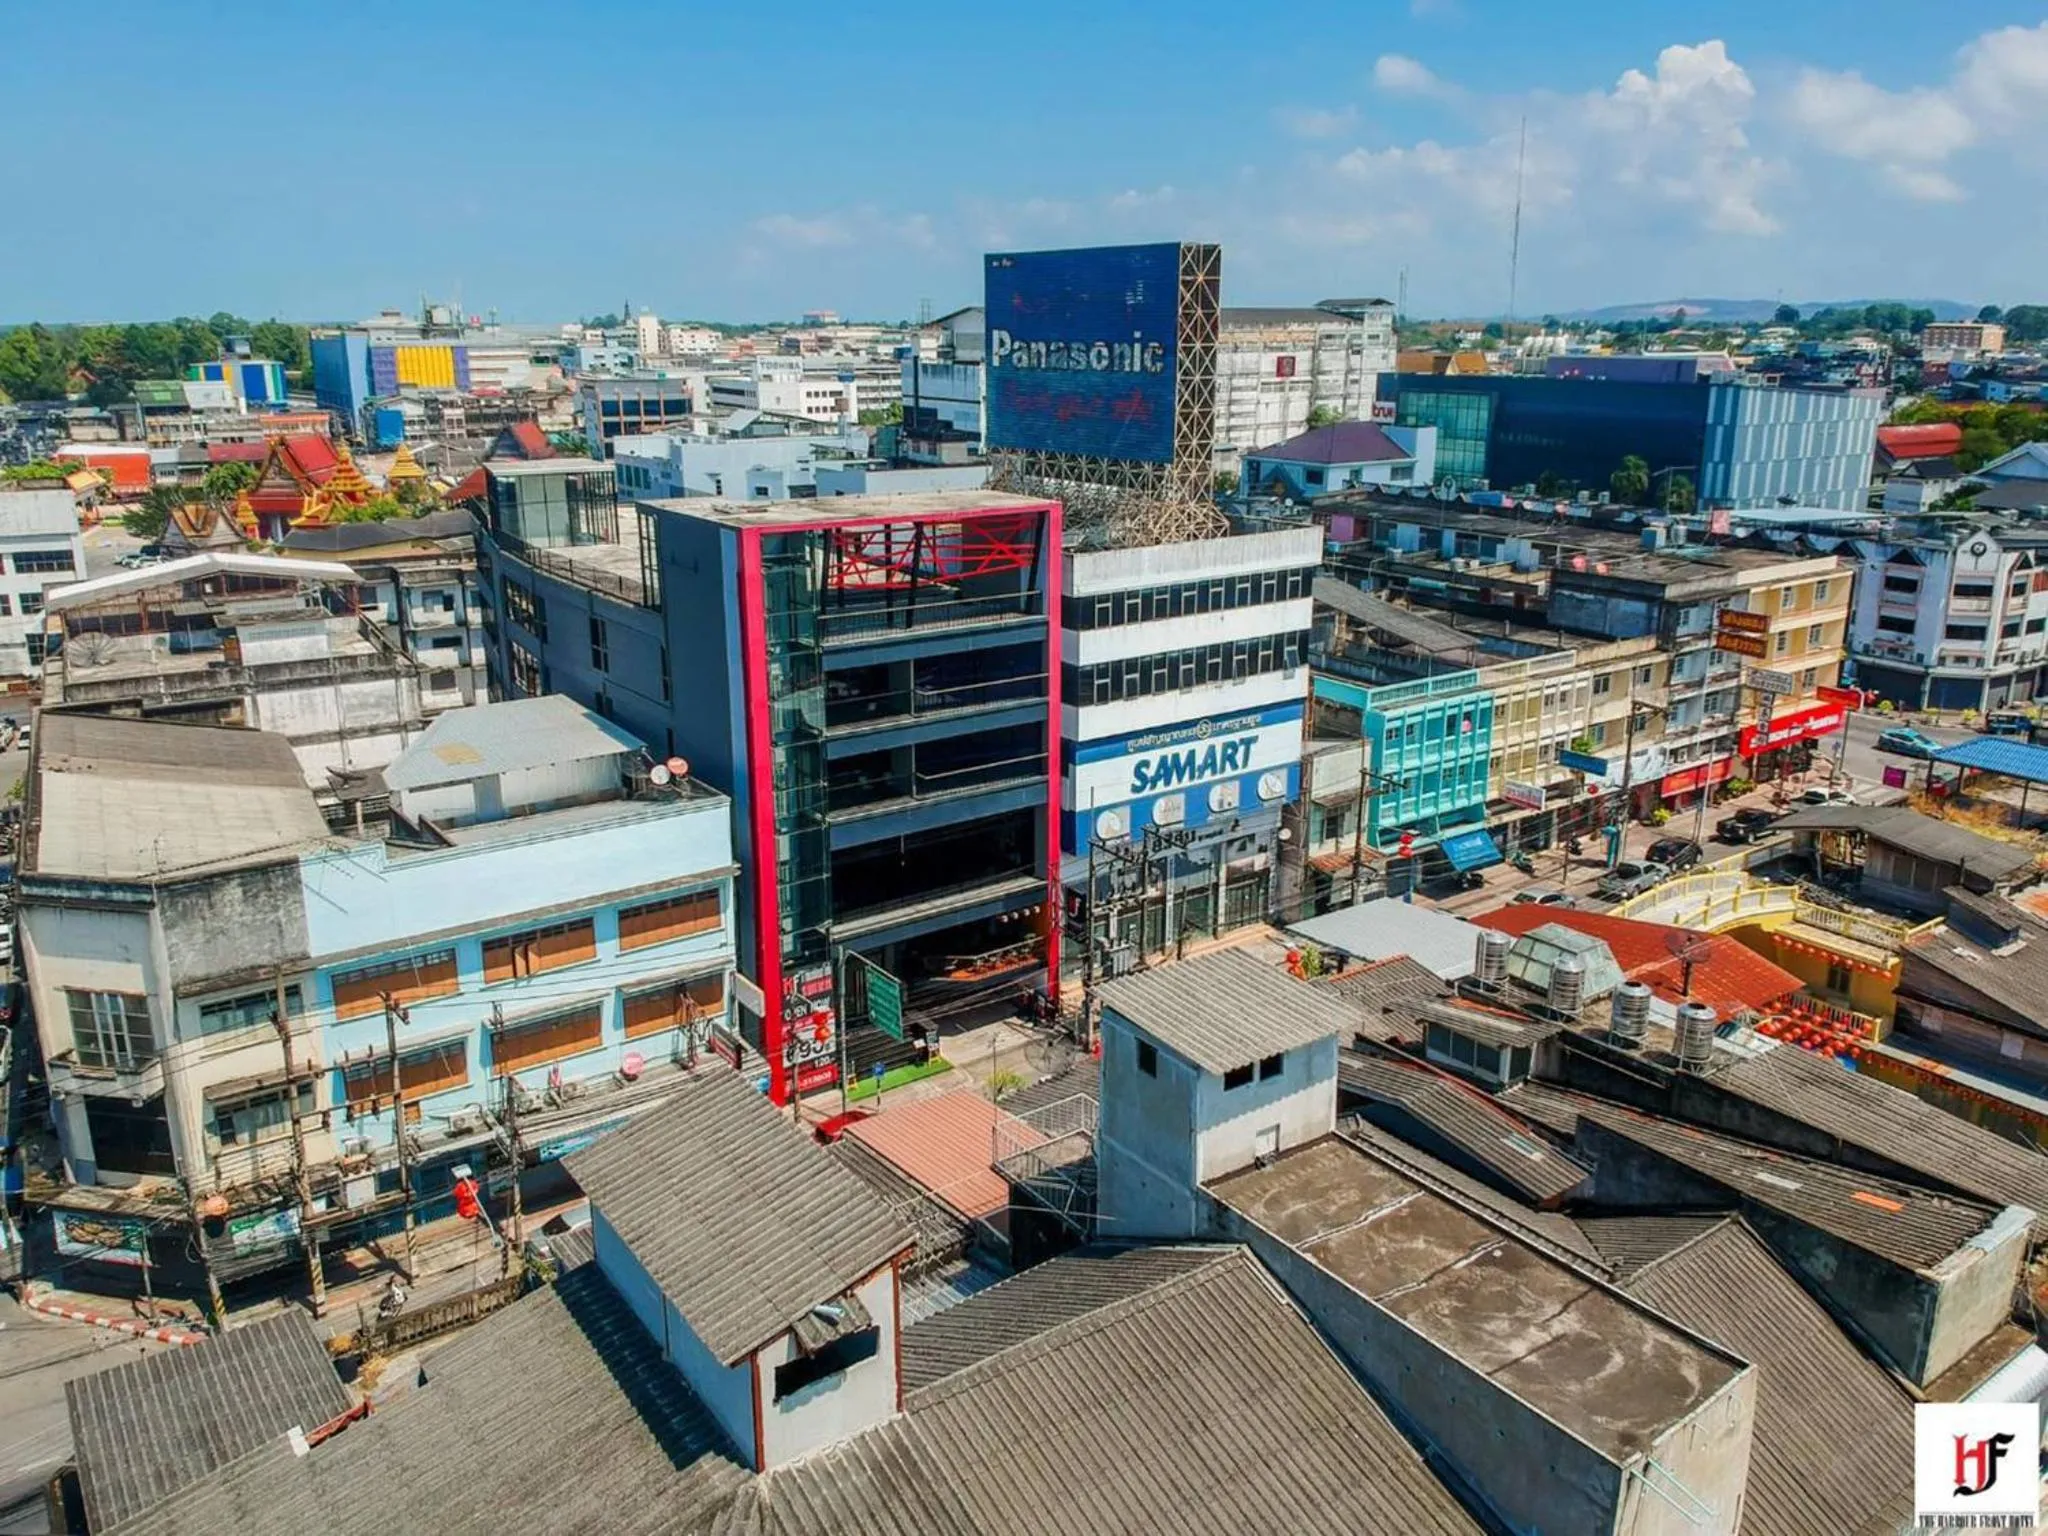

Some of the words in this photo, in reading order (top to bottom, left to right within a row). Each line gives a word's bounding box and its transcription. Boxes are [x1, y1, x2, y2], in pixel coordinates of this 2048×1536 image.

[760, 361, 801, 370] TOSHIBA
[991, 328, 1165, 373] Panasonic
[1130, 734, 1259, 795] SAMART
